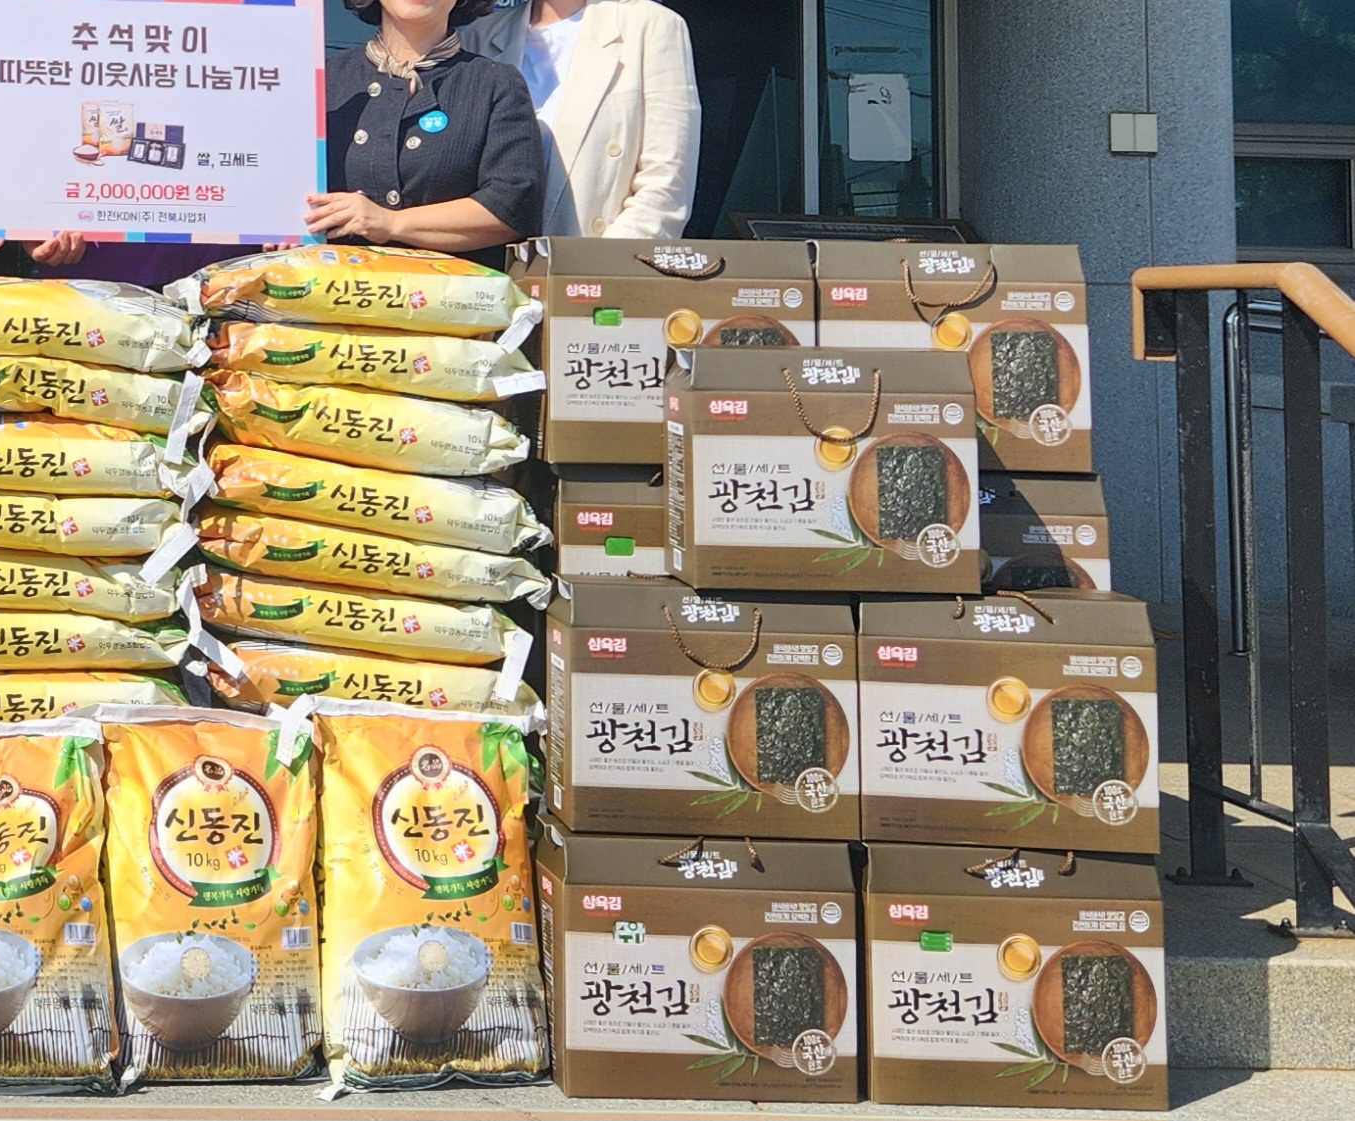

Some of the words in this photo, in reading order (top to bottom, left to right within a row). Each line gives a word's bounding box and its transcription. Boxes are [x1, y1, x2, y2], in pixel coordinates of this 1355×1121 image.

[0, 60, 73, 86] 따뜻한
[81, 61, 178, 88] 이웃사랑
[186, 65, 281, 92] 나눔기부
[219, 152, 259, 168] 김세트
[65, 182, 80, 199] 금
[85, 183, 190, 203] 2,000,000원
[195, 185, 225, 202] 상당
[159, 211, 206, 223] 전북사업처
[325, 280, 405, 309] 신동진
[566, 284, 602, 297] 삼육김
[831, 287, 868, 301] 삼육김
[3, 318, 82, 346] 신동진
[566, 342, 641, 354] 선/물/세/트
[329, 344, 408, 375] 신동진
[563, 356, 665, 390] 광천김
[12, 368, 86, 404] 신동진
[710, 400, 748, 415] 삼육김
[316, 405, 395, 442] 신동진
[1036, 419, 1062, 432] 국산
[711, 463, 791, 475] 선/물/세/트
[330, 485, 410, 521] 신동진
[708, 479, 816, 513] 광천김
[577, 512, 613, 525] 삼육김
[925, 540, 953, 553] 국산
[331, 543, 411, 578] 신동진
[317, 600, 398, 632] 신동진
[587, 637, 628, 653] 삼육김
[877, 646, 918, 662] 삼육김
[344, 673, 423, 706] 신동진
[589, 702, 669, 714] 선/물/세/트
[880, 710, 962, 724] 선/물/세/트
[585, 719, 694, 753] 광천김
[876, 728, 985, 764] 광천김
[802, 783, 829, 798] 국산
[1101, 797, 1129, 812] 국산
[164, 806, 264, 845] 신동진
[391, 804, 490, 841] 신동진
[582, 896, 621, 911] 삼육김
[889, 904, 929, 920] 삼육김
[584, 963, 665, 975] 선/물/세/트
[891, 971, 973, 983] 선/물/세/트
[580, 979, 690, 1017] 광천김
[888, 989, 998, 1025] 광천김
[799, 1045, 827, 1060] 국산
[1108, 1053, 1137, 1068] 국산
